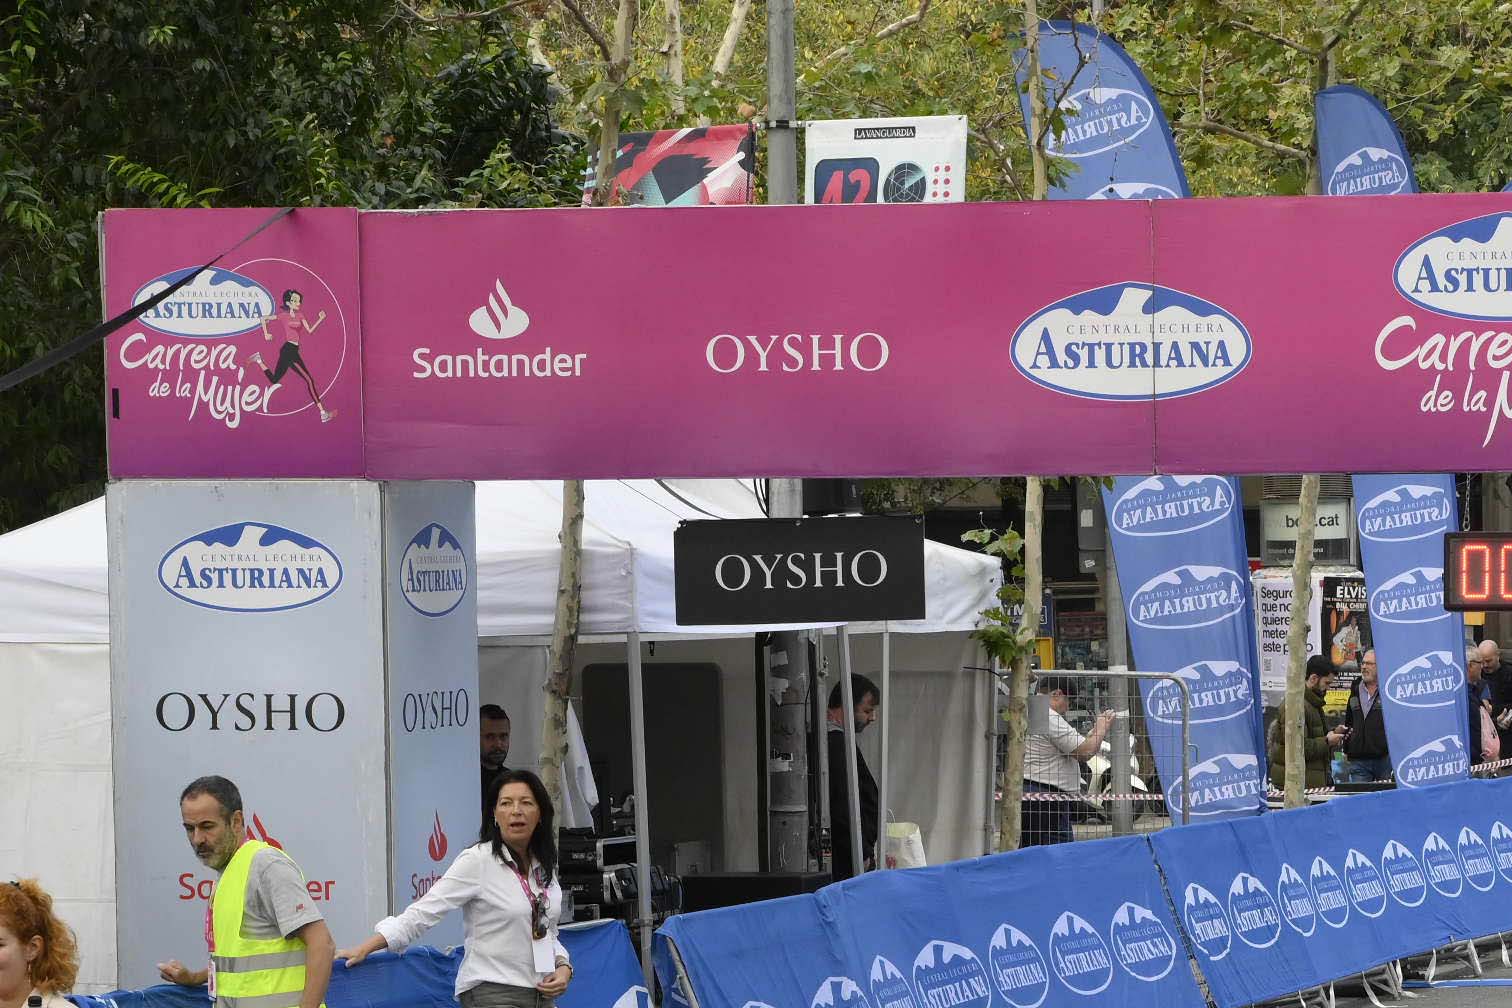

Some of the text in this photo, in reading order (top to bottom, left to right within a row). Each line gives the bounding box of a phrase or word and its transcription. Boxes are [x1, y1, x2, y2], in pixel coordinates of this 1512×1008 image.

[171, 288, 260, 299] ENTRAL LECHERA
[1066, 322, 1225, 335] CENTRAL LECHERA
[119, 332, 238, 370] Carrera
[412, 346, 587, 379] Santander
[705, 332, 890, 374] OYSHO
[1029, 326, 1234, 370] ASTURIANA
[148, 367, 283, 430] de la Mujer
[1420, 373, 1454, 413] de
[1462, 371, 1488, 413] la
[172, 555, 330, 591] ASTURIANA
[201, 553, 324, 563] CENTRAL LECHERA
[405, 557, 464, 593] ASTURIANA
[714, 549, 889, 593] OYSHO
[1263, 641, 1282, 653] este
[155, 692, 346, 732] OYSHO
[402, 688, 469, 732] OYSHO
[1055, 945, 1110, 977] ASTURIANA
